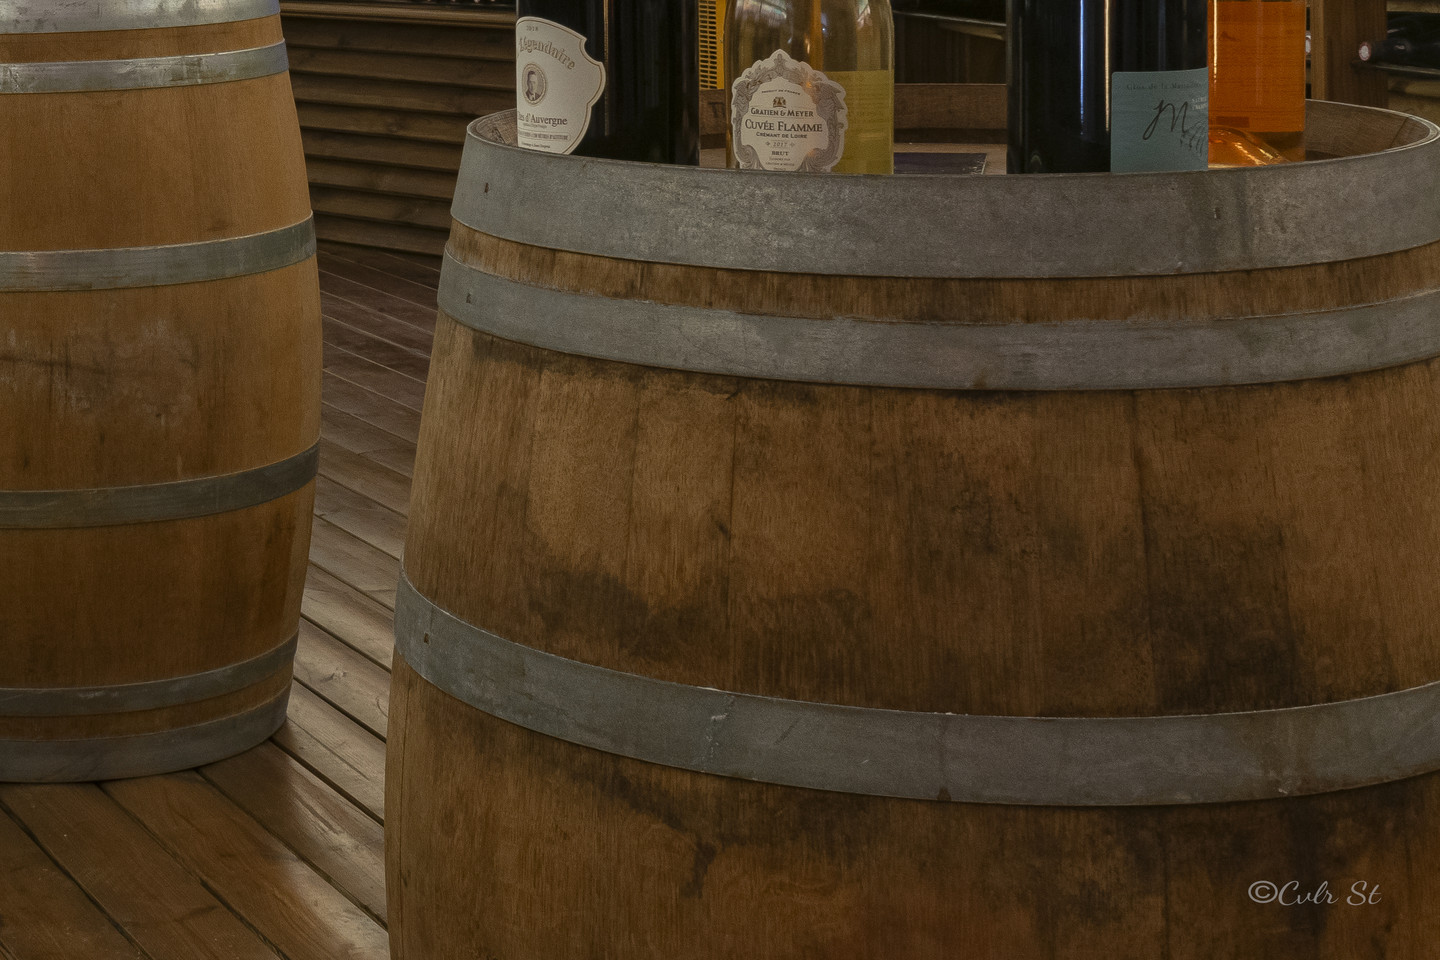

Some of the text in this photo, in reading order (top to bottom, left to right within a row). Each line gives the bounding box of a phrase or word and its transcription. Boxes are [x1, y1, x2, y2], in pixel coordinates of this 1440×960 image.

[750, 107, 779, 116] GRATIEN
[780, 109, 786, 117] &
[525, 112, 569, 128] d'Auvergne
[745, 119, 823, 132] CUVÉE FLAMME
